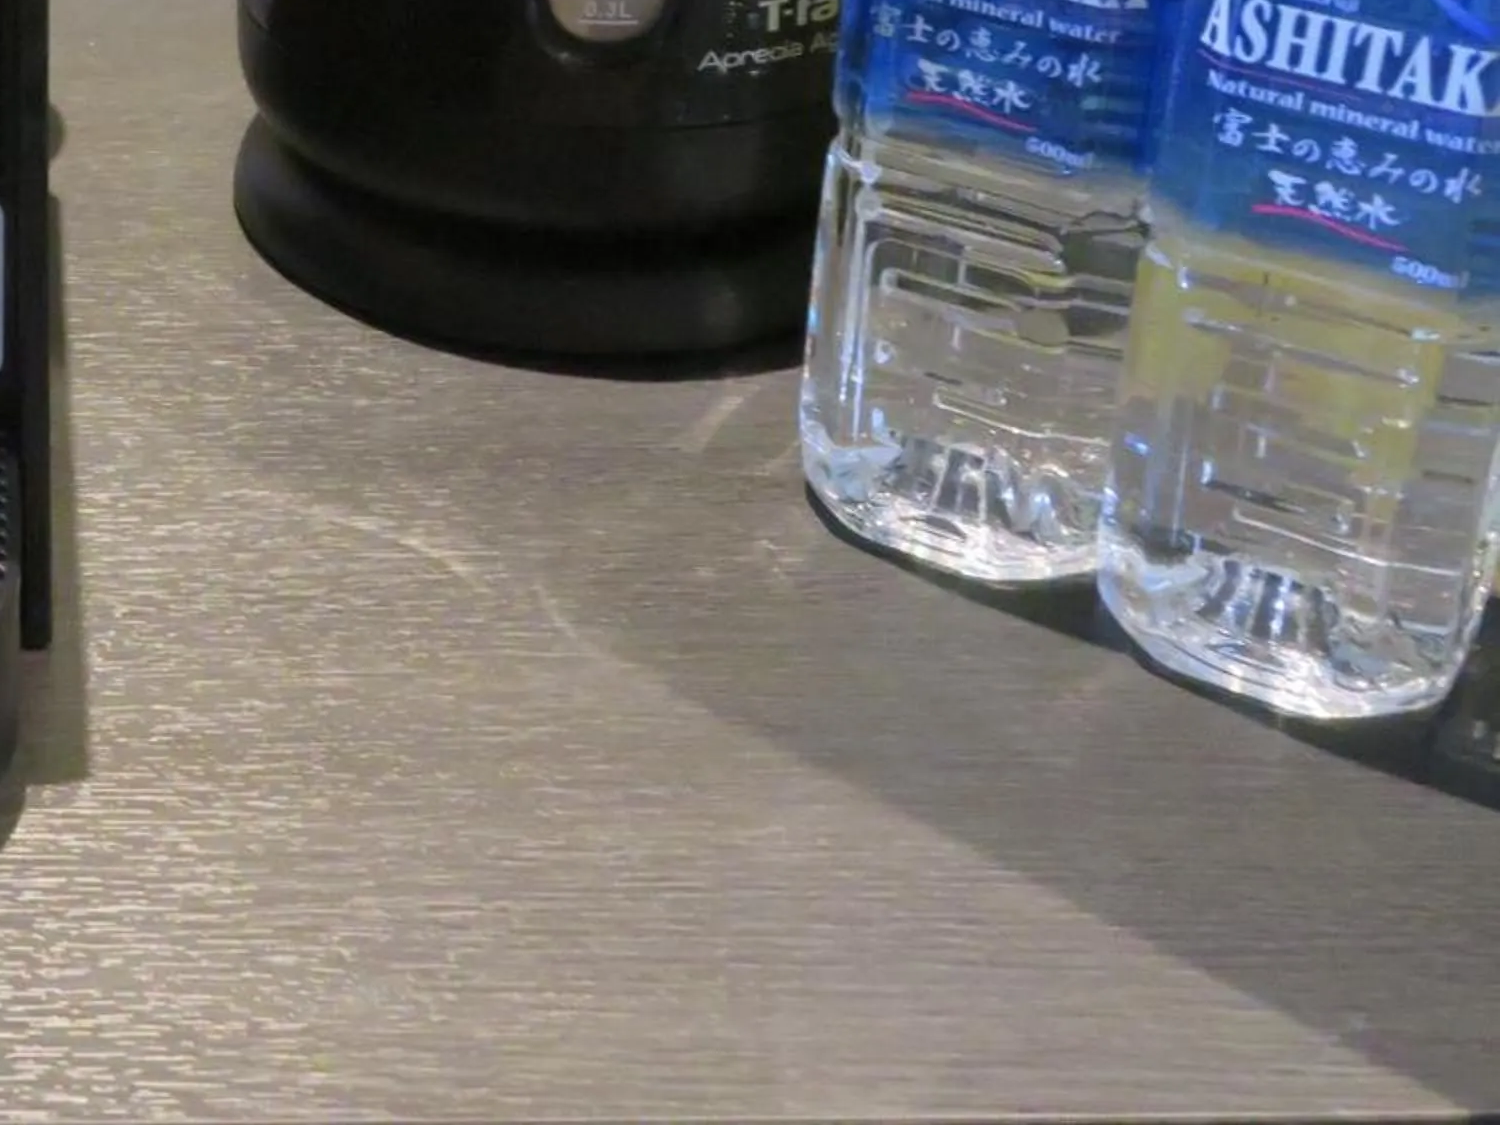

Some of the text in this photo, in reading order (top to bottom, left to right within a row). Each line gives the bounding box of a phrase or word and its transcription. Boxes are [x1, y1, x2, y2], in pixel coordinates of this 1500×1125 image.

[870, 3, 1103, 88] 富士の恵みの水
[1048, 17, 1121, 44] water
[917, 57, 1032, 113] 天然水
[1206, 68, 1304, 112] Natural
[1308, 97, 1421, 141] mineral
[1212, 106, 1483, 205] 富士の恵みの水
[1266, 169, 1401, 230] 天然水
